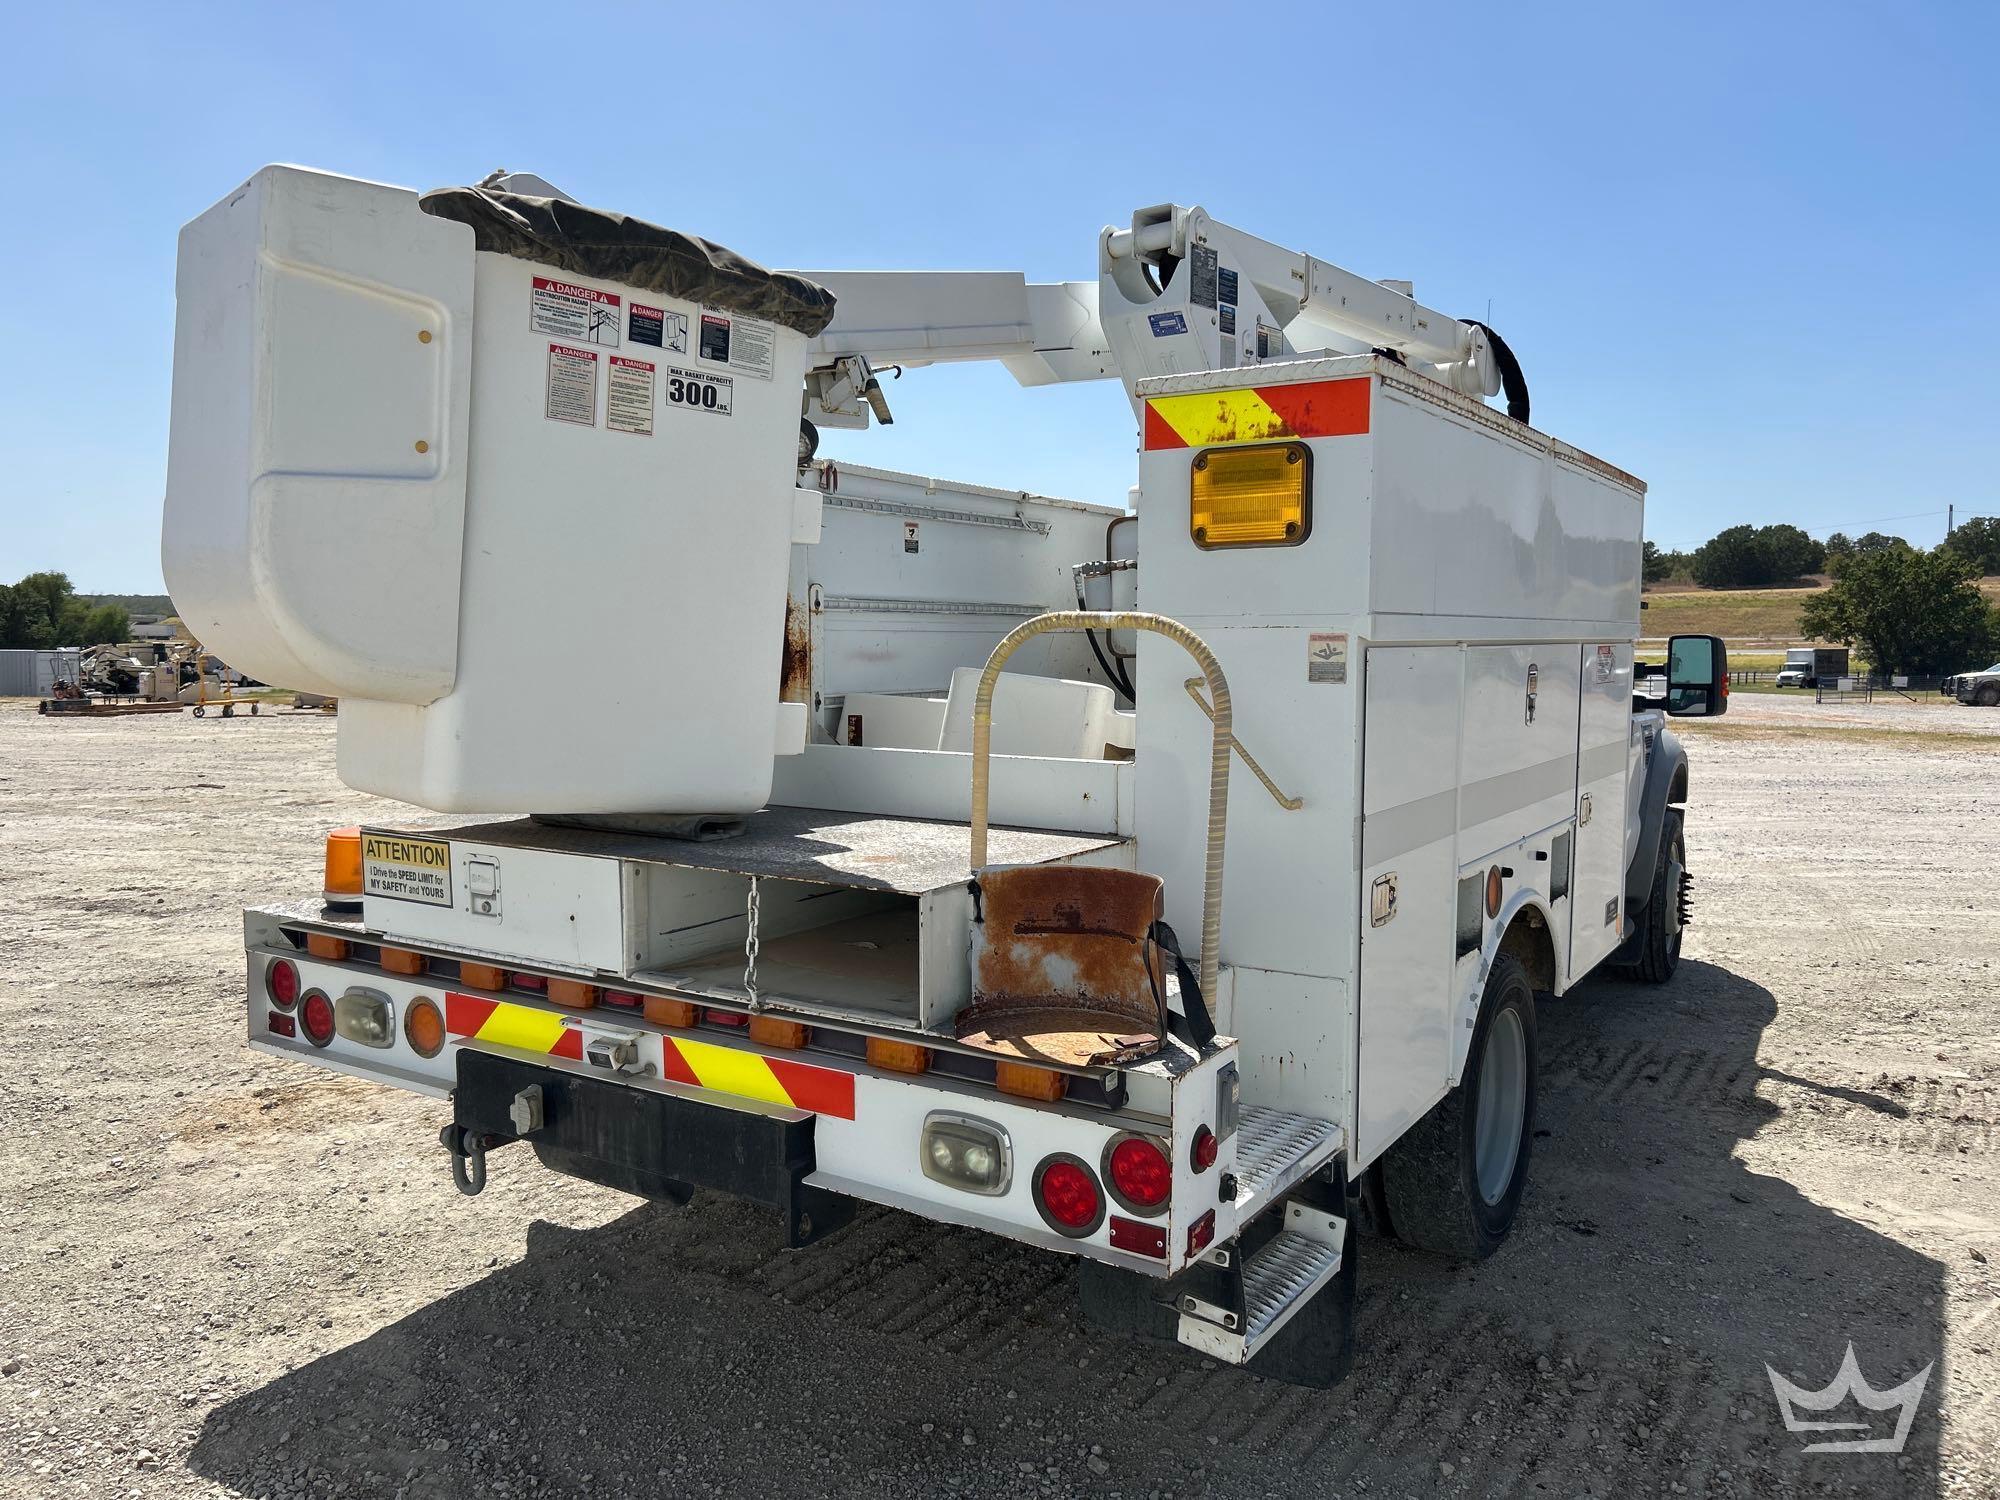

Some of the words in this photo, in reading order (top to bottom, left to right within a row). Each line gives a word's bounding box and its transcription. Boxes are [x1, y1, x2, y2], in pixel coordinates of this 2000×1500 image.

[556, 284, 598, 301] DANGER
[571, 298, 589, 307] HAZARD
[637, 306, 663, 320] DANGER
[707, 316, 729, 326] DANGER
[562, 349, 593, 359] DANGER
[624, 359, 650, 370] DANGER
[670, 368, 684, 376] MAX.
[685, 371, 705, 381] BASKET
[706, 375, 732, 385] CAPACITY
[669, 378, 717, 409] 300
[717, 403, 729, 412] LBS.
[366, 839, 445, 866] ATTENTION
[370, 866, 373, 875] I
[373, 866, 388, 878] Drive
[388, 868, 398, 879] the
[398, 869, 417, 882] SPEED
[418, 873, 434, 884] LIMIT
[434, 874, 444, 885] for
[370, 878, 381, 889] MY
[382, 880, 408, 893] SAFETY
[408, 884, 420, 895] and
[420, 885, 445, 899] YOURS
